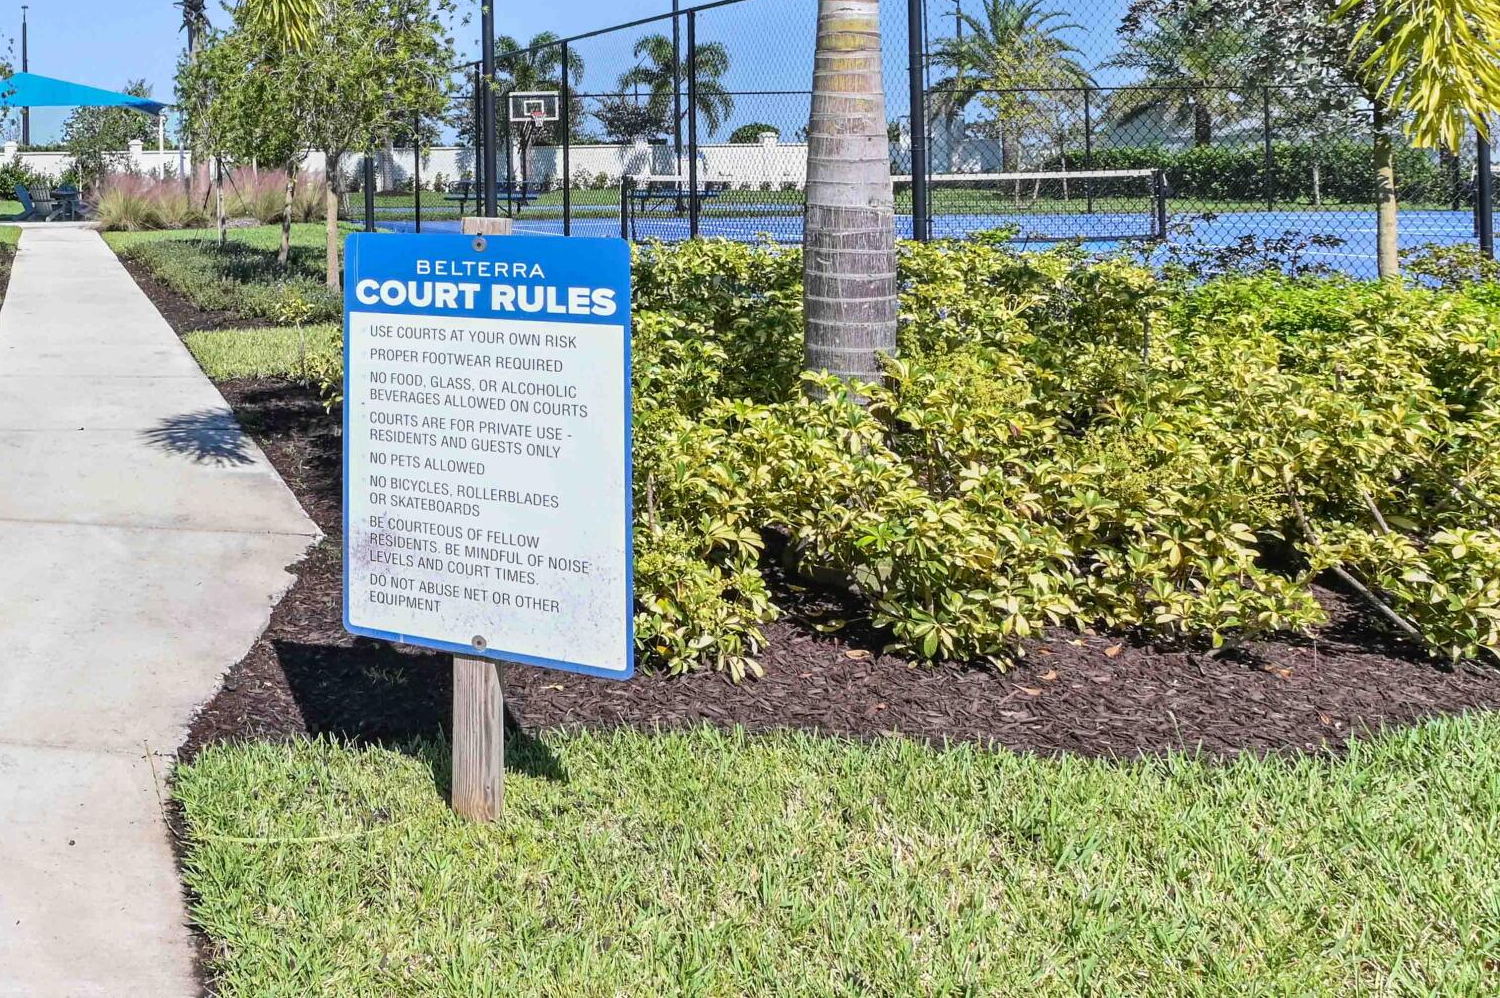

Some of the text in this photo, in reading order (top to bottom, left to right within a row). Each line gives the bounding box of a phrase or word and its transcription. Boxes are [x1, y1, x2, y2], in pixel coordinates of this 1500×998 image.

[417, 260, 544, 278] BELTERRA
[356, 279, 616, 316] COURT RULES
[370, 325, 576, 348] USE COURTS AT YOUR OWN RISK
[370, 348, 563, 372] PROPER FOOTWEAR REQUIRED
[370, 371, 576, 398] NO FOOD, GLASS, OR ALCOHOLIC
[370, 388, 588, 418] BEVERAGES ALLOWED ON COURTS
[370, 412, 418, 427] COURTS
[422, 416, 445, 430] ARE
[450, 418, 474, 432] FOR
[479, 421, 532, 438] PRIVATE
[537, 427, 562, 440] USE
[370, 428, 560, 458] RESIDENTS AND GUESTS ONLY
[370, 452, 485, 475] NO PETS ALLOWED
[370, 475, 559, 508] NO BICYCLES, ROLLERBLADES
[370, 492, 480, 517] OR SKATEBOARDS
[370, 515, 540, 548] BE COURTEOUS OF FELLOW
[370, 532, 589, 574] RESIDENTS. BE MINDFUL OF NOISE
[370, 550, 539, 586] LEVELS AND COURT TIMES.
[370, 573, 559, 613] DO NOT ABUSE NET OR OTHER
[370, 590, 440, 612] EQUIPMENT
